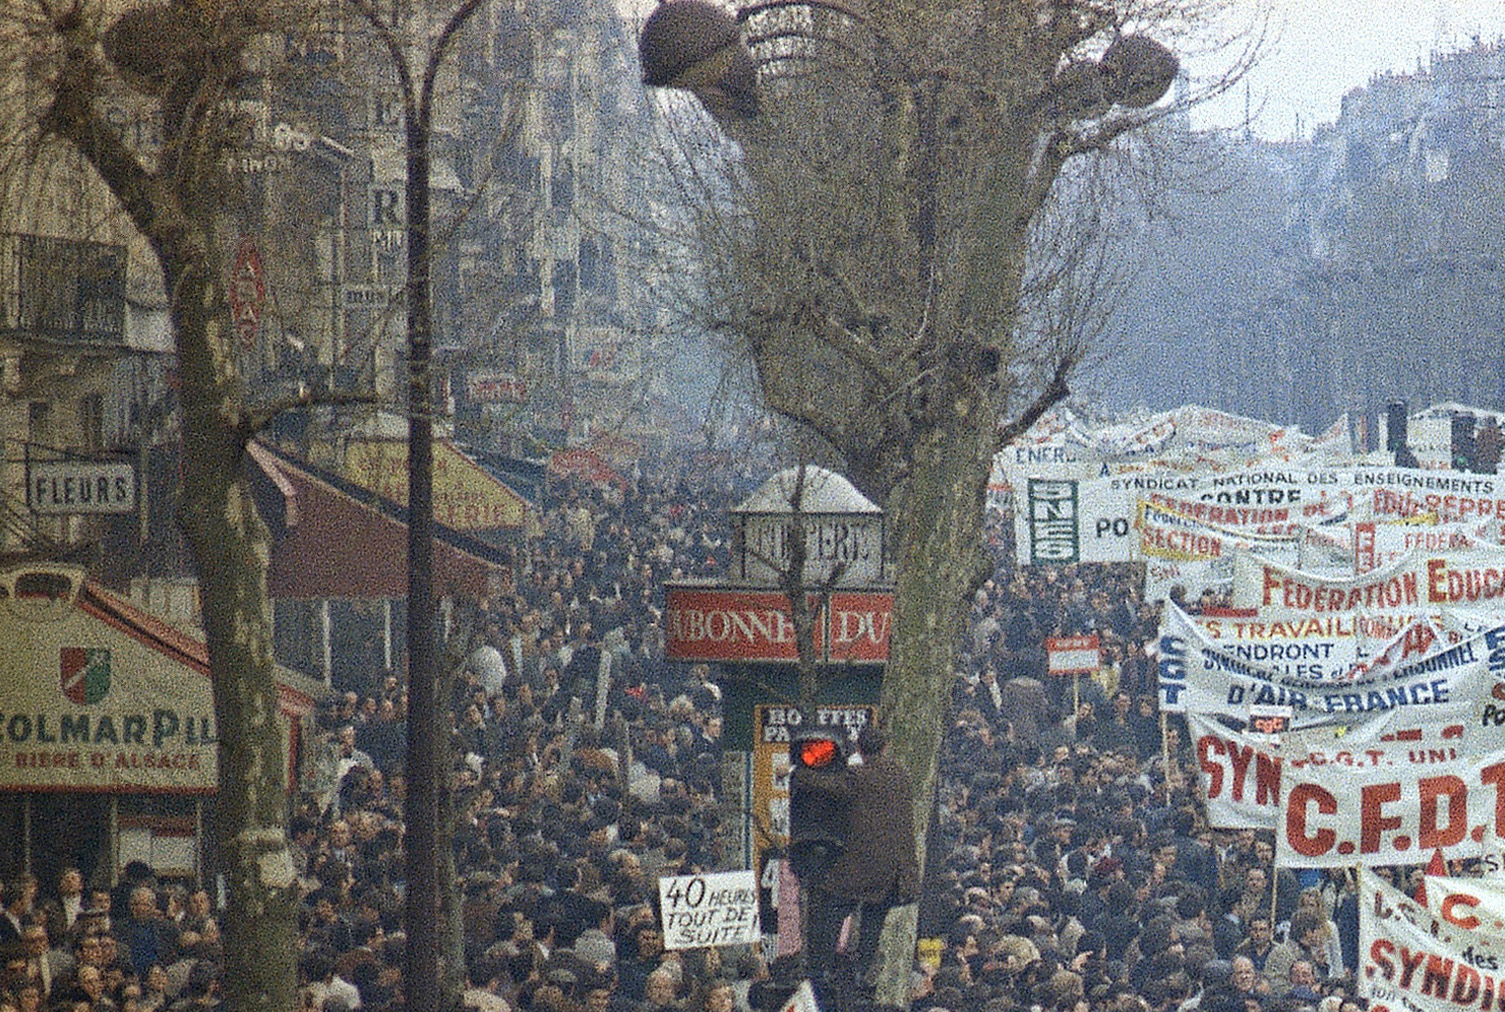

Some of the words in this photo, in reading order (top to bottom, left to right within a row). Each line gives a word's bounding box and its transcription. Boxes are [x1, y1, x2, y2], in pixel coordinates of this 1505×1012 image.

[36, 476, 129, 503] FLEURS
[1111, 475, 1198, 492] SYNDICAT
[1214, 469, 1298, 487] NATIONAL
[1308, 472, 1339, 485] DES
[1354, 473, 1494, 496] ENSEIGNEMENTS
[1158, 635, 1187, 704] CGT
[1326, 678, 1450, 713] FRANCE
[665, 877, 707, 909] 40
[666, 910, 719, 930] TOUT
[724, 906, 752, 925] DE
[679, 925, 744, 944] SUITE
